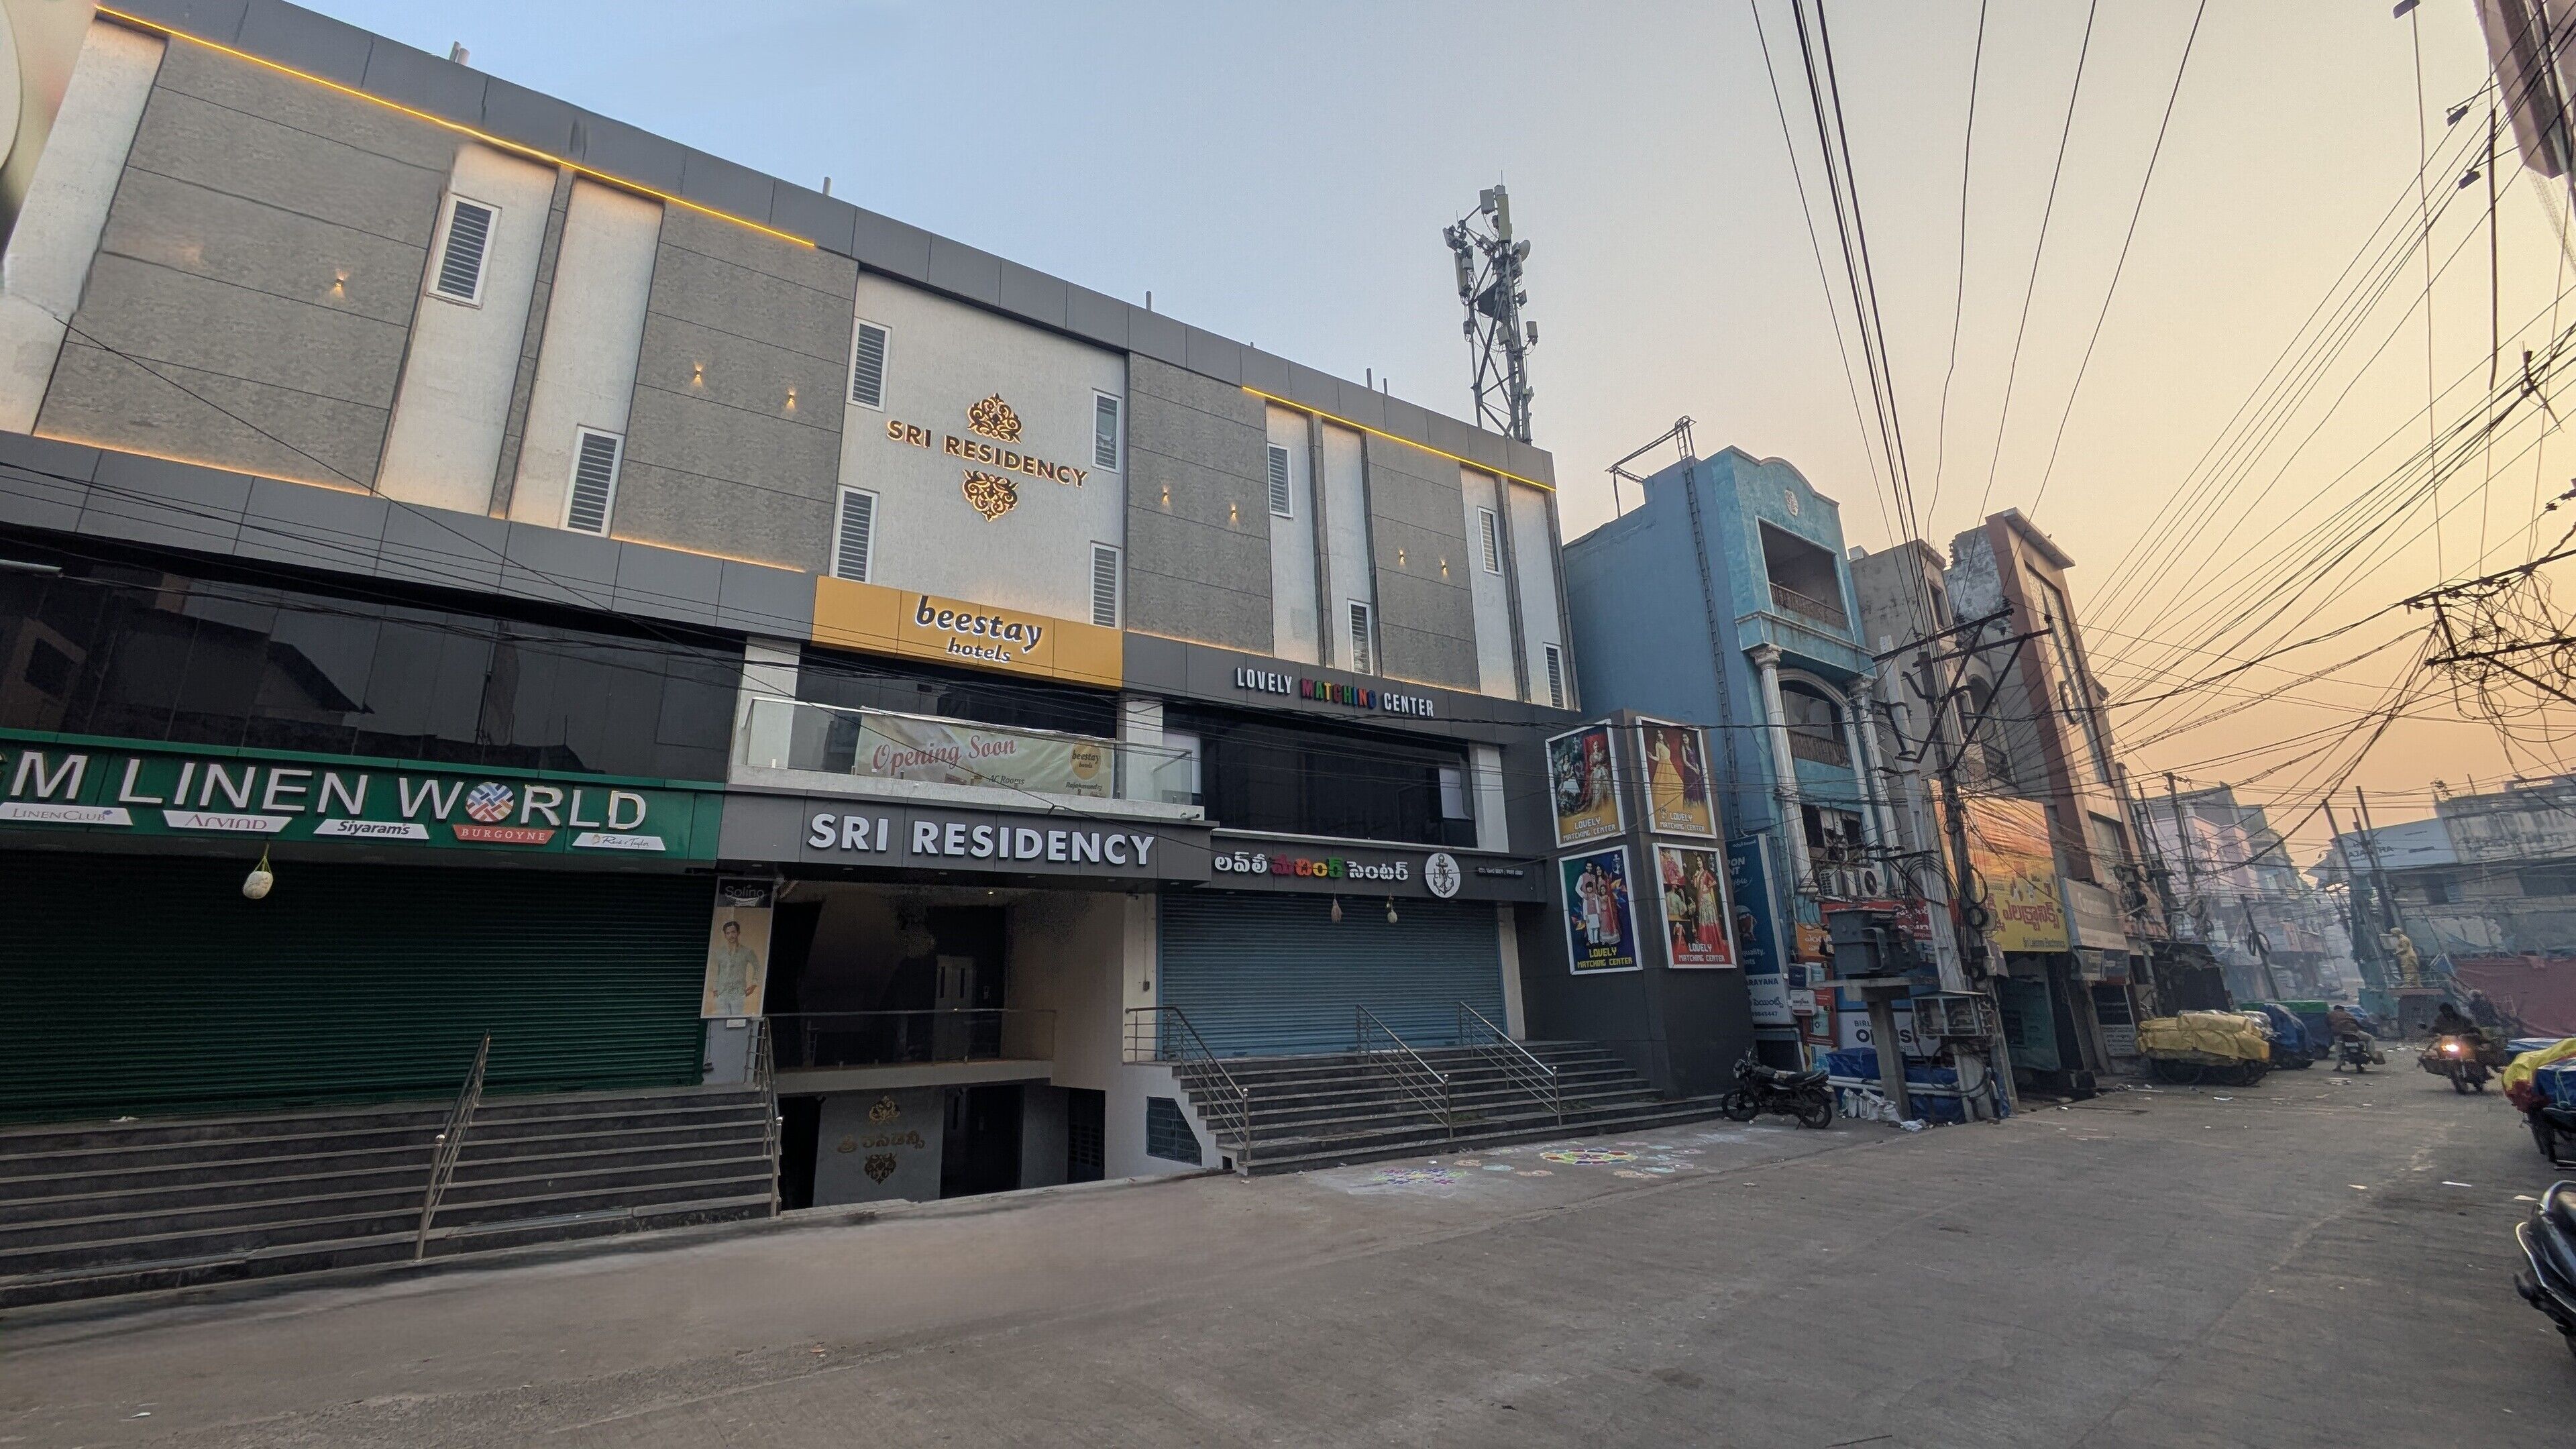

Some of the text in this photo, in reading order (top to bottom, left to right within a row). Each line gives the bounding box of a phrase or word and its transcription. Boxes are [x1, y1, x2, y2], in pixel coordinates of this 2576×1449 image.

[887, 420, 1088, 488] SRI RESIDENCY
[915, 595, 1042, 653] beestay
[947, 637, 1011, 663] hotels
[1237, 667, 1434, 717] LOVELY MATCHING CENTER
[873, 735, 1016, 776] Opening Soon
[1072, 749, 1100, 764] beestay
[0, 751, 647, 830] M LINEN WORLD
[1574, 816, 1601, 830] LOVELY
[1670, 812, 1693, 822] LOVELY
[1563, 824, 1616, 841] MATCHING CENTER
[1660, 822, 1705, 832] MATCHING CENTER
[461, 828, 546, 842] BURGOYNE
[808, 813, 1155, 865] SRI RESIDENCY
[1589, 947, 1617, 958] LOVELY
[1688, 943, 1712, 952] LOVELY
[1577, 957, 1633, 969] MATCHING CENTER
[1678, 954, 1704, 962] MATCHING
